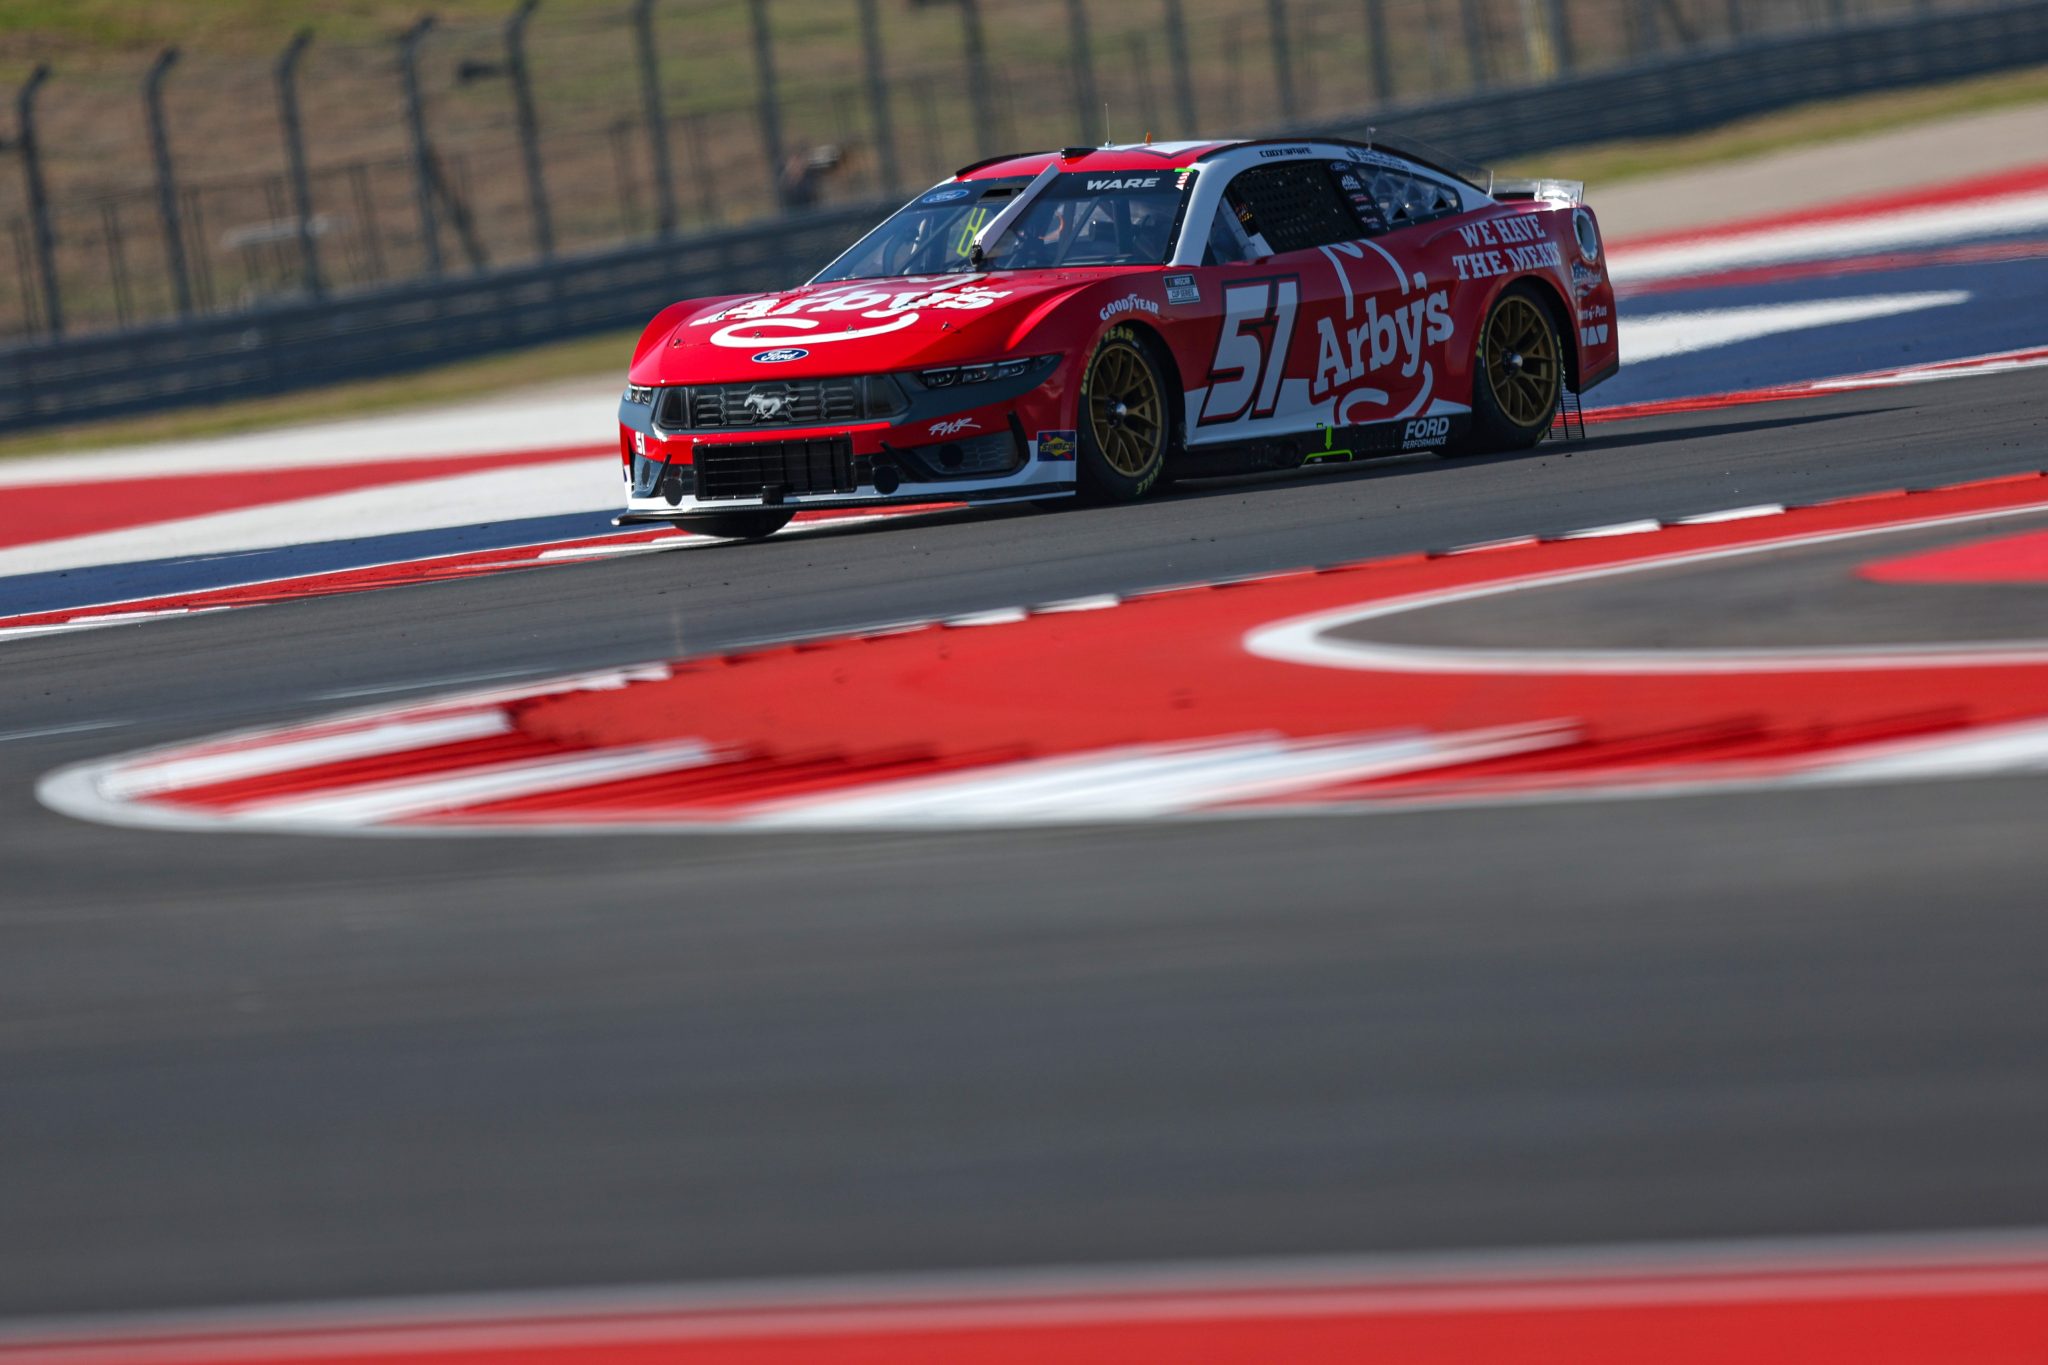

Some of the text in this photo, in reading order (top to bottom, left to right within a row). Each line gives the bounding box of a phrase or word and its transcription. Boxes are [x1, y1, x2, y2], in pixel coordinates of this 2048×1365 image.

[1086, 177, 1160, 191] WARE
[1458, 215, 1546, 248] WE HAVE
[1452, 241, 1562, 280] THE MEATS
[690, 287, 1014, 326] Arby's
[1100, 293, 1159, 320] GOODYEAR
[1313, 271, 1454, 396] Arby's
[759, 351, 800, 362] Ford
[1199, 277, 1298, 423] 51
[1404, 417, 1450, 440] FORD
[635, 431, 646, 456] 51
[1039, 441, 1075, 452] SUNOCO
[1402, 436, 1447, 449] PERFORMANCE
